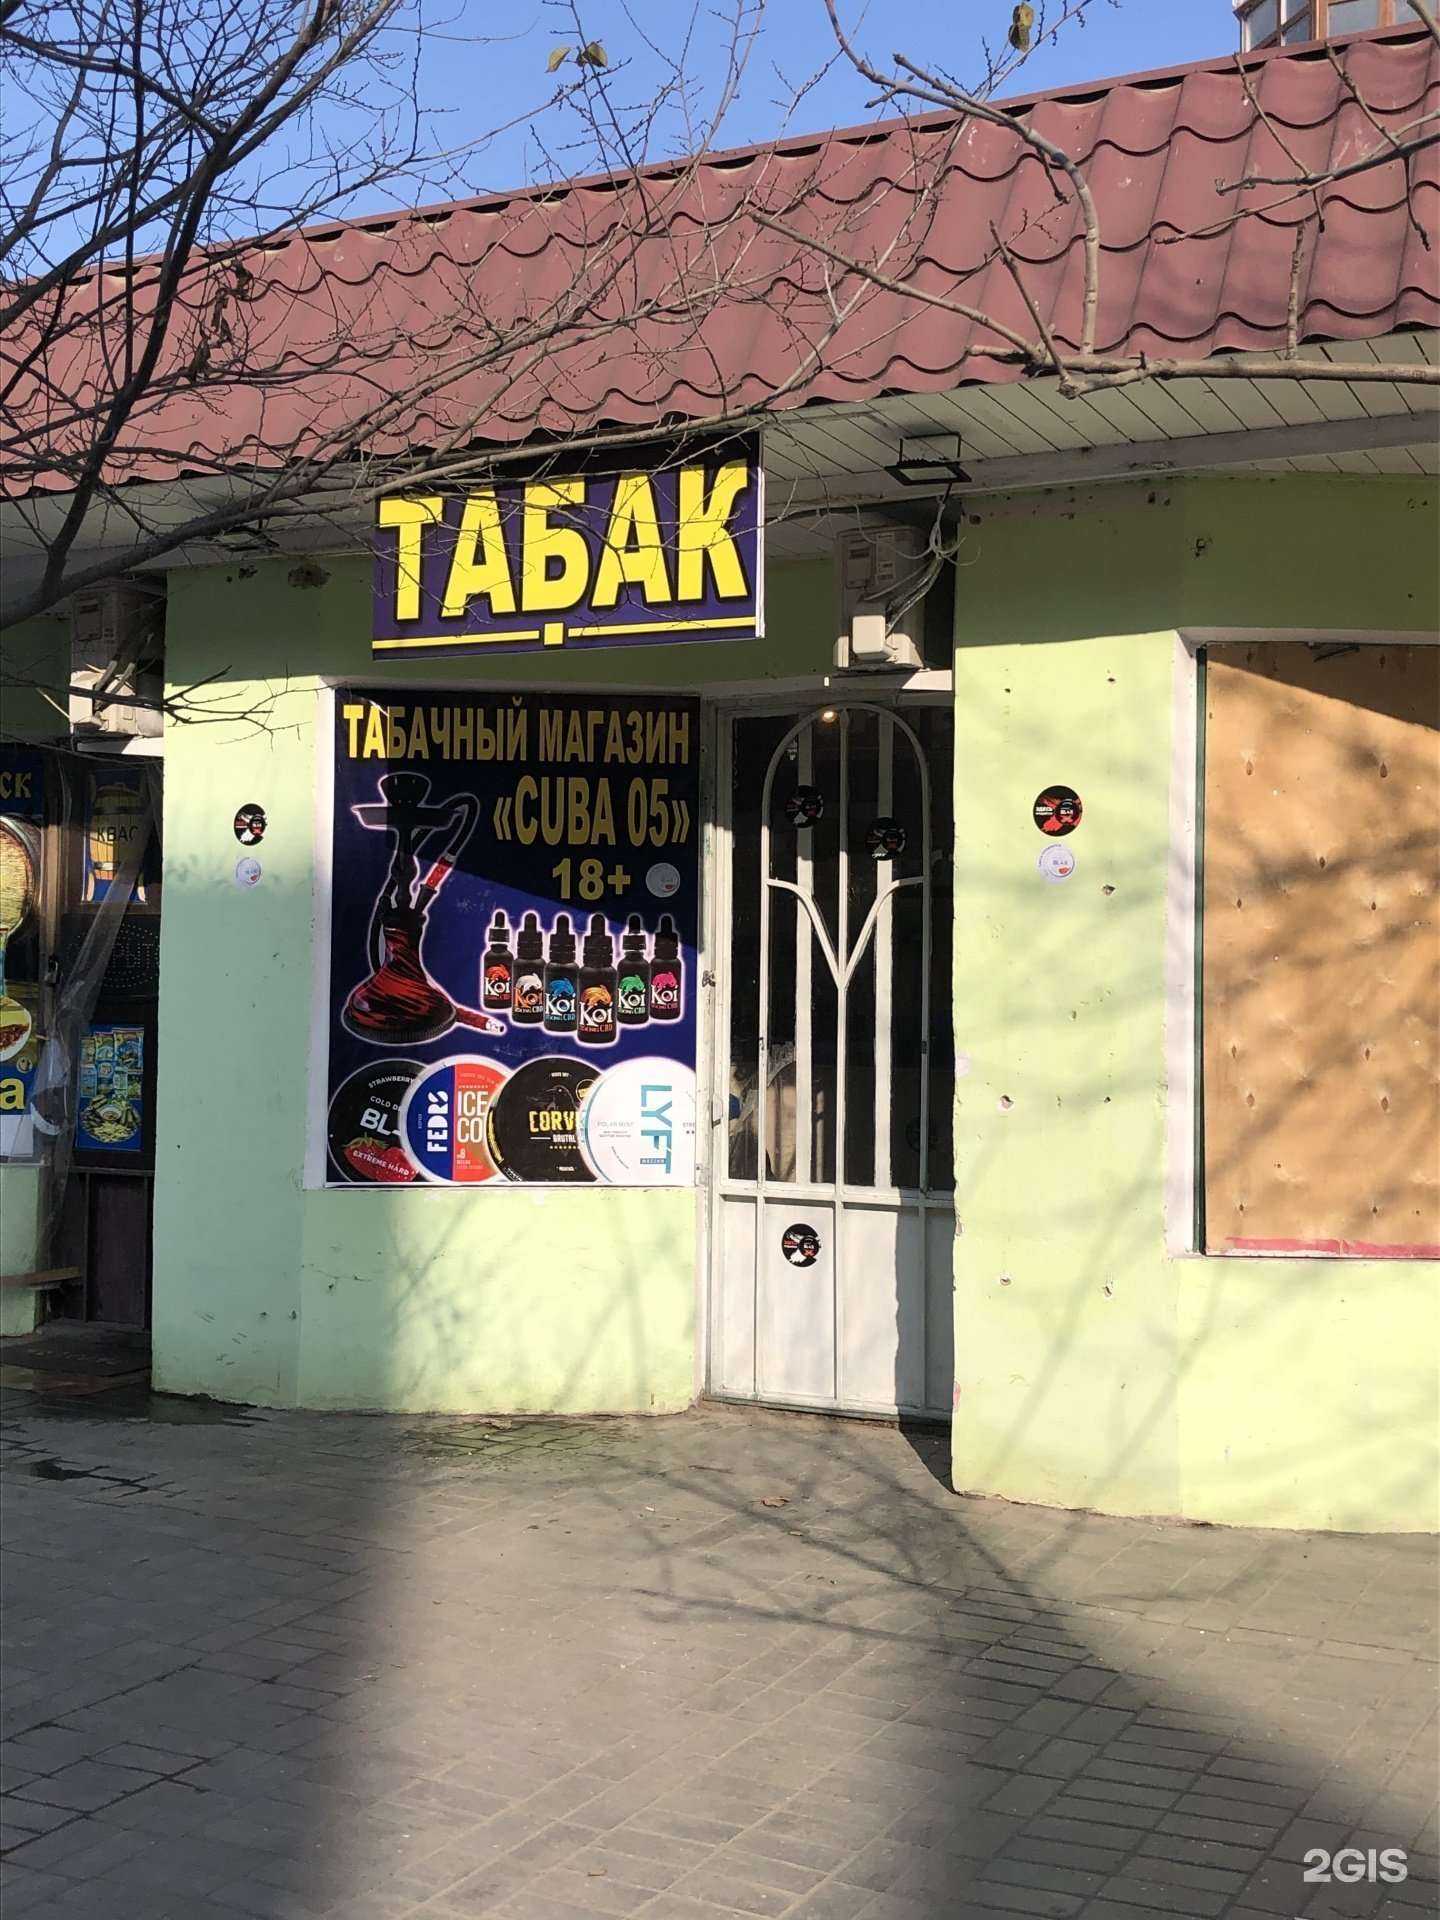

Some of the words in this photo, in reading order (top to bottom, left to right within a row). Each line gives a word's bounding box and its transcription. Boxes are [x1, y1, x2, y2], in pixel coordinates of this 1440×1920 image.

[378, 458, 750, 621] ТАБАК
[343, 696, 527, 761] ТАБАЧНЫЙ
[538, 709, 689, 765] МАГАЗИН
[493, 775, 617, 847] «CUBA
[627, 777, 691, 847] 05»
[552, 858, 631, 900] 18+
[484, 976, 511, 997] Koi
[514, 986, 544, 1009] Koi
[618, 988, 646, 1011] Koi
[651, 984, 680, 1006] Koi
[545, 993, 576, 1016] Koi
[579, 1002, 614, 1028] Koi
[370, 1095, 391, 1108] COLD
[457, 1090, 489, 1118] ICE
[426, 1090, 449, 1152] FEDRS
[640, 1084, 673, 1175] LYFT
